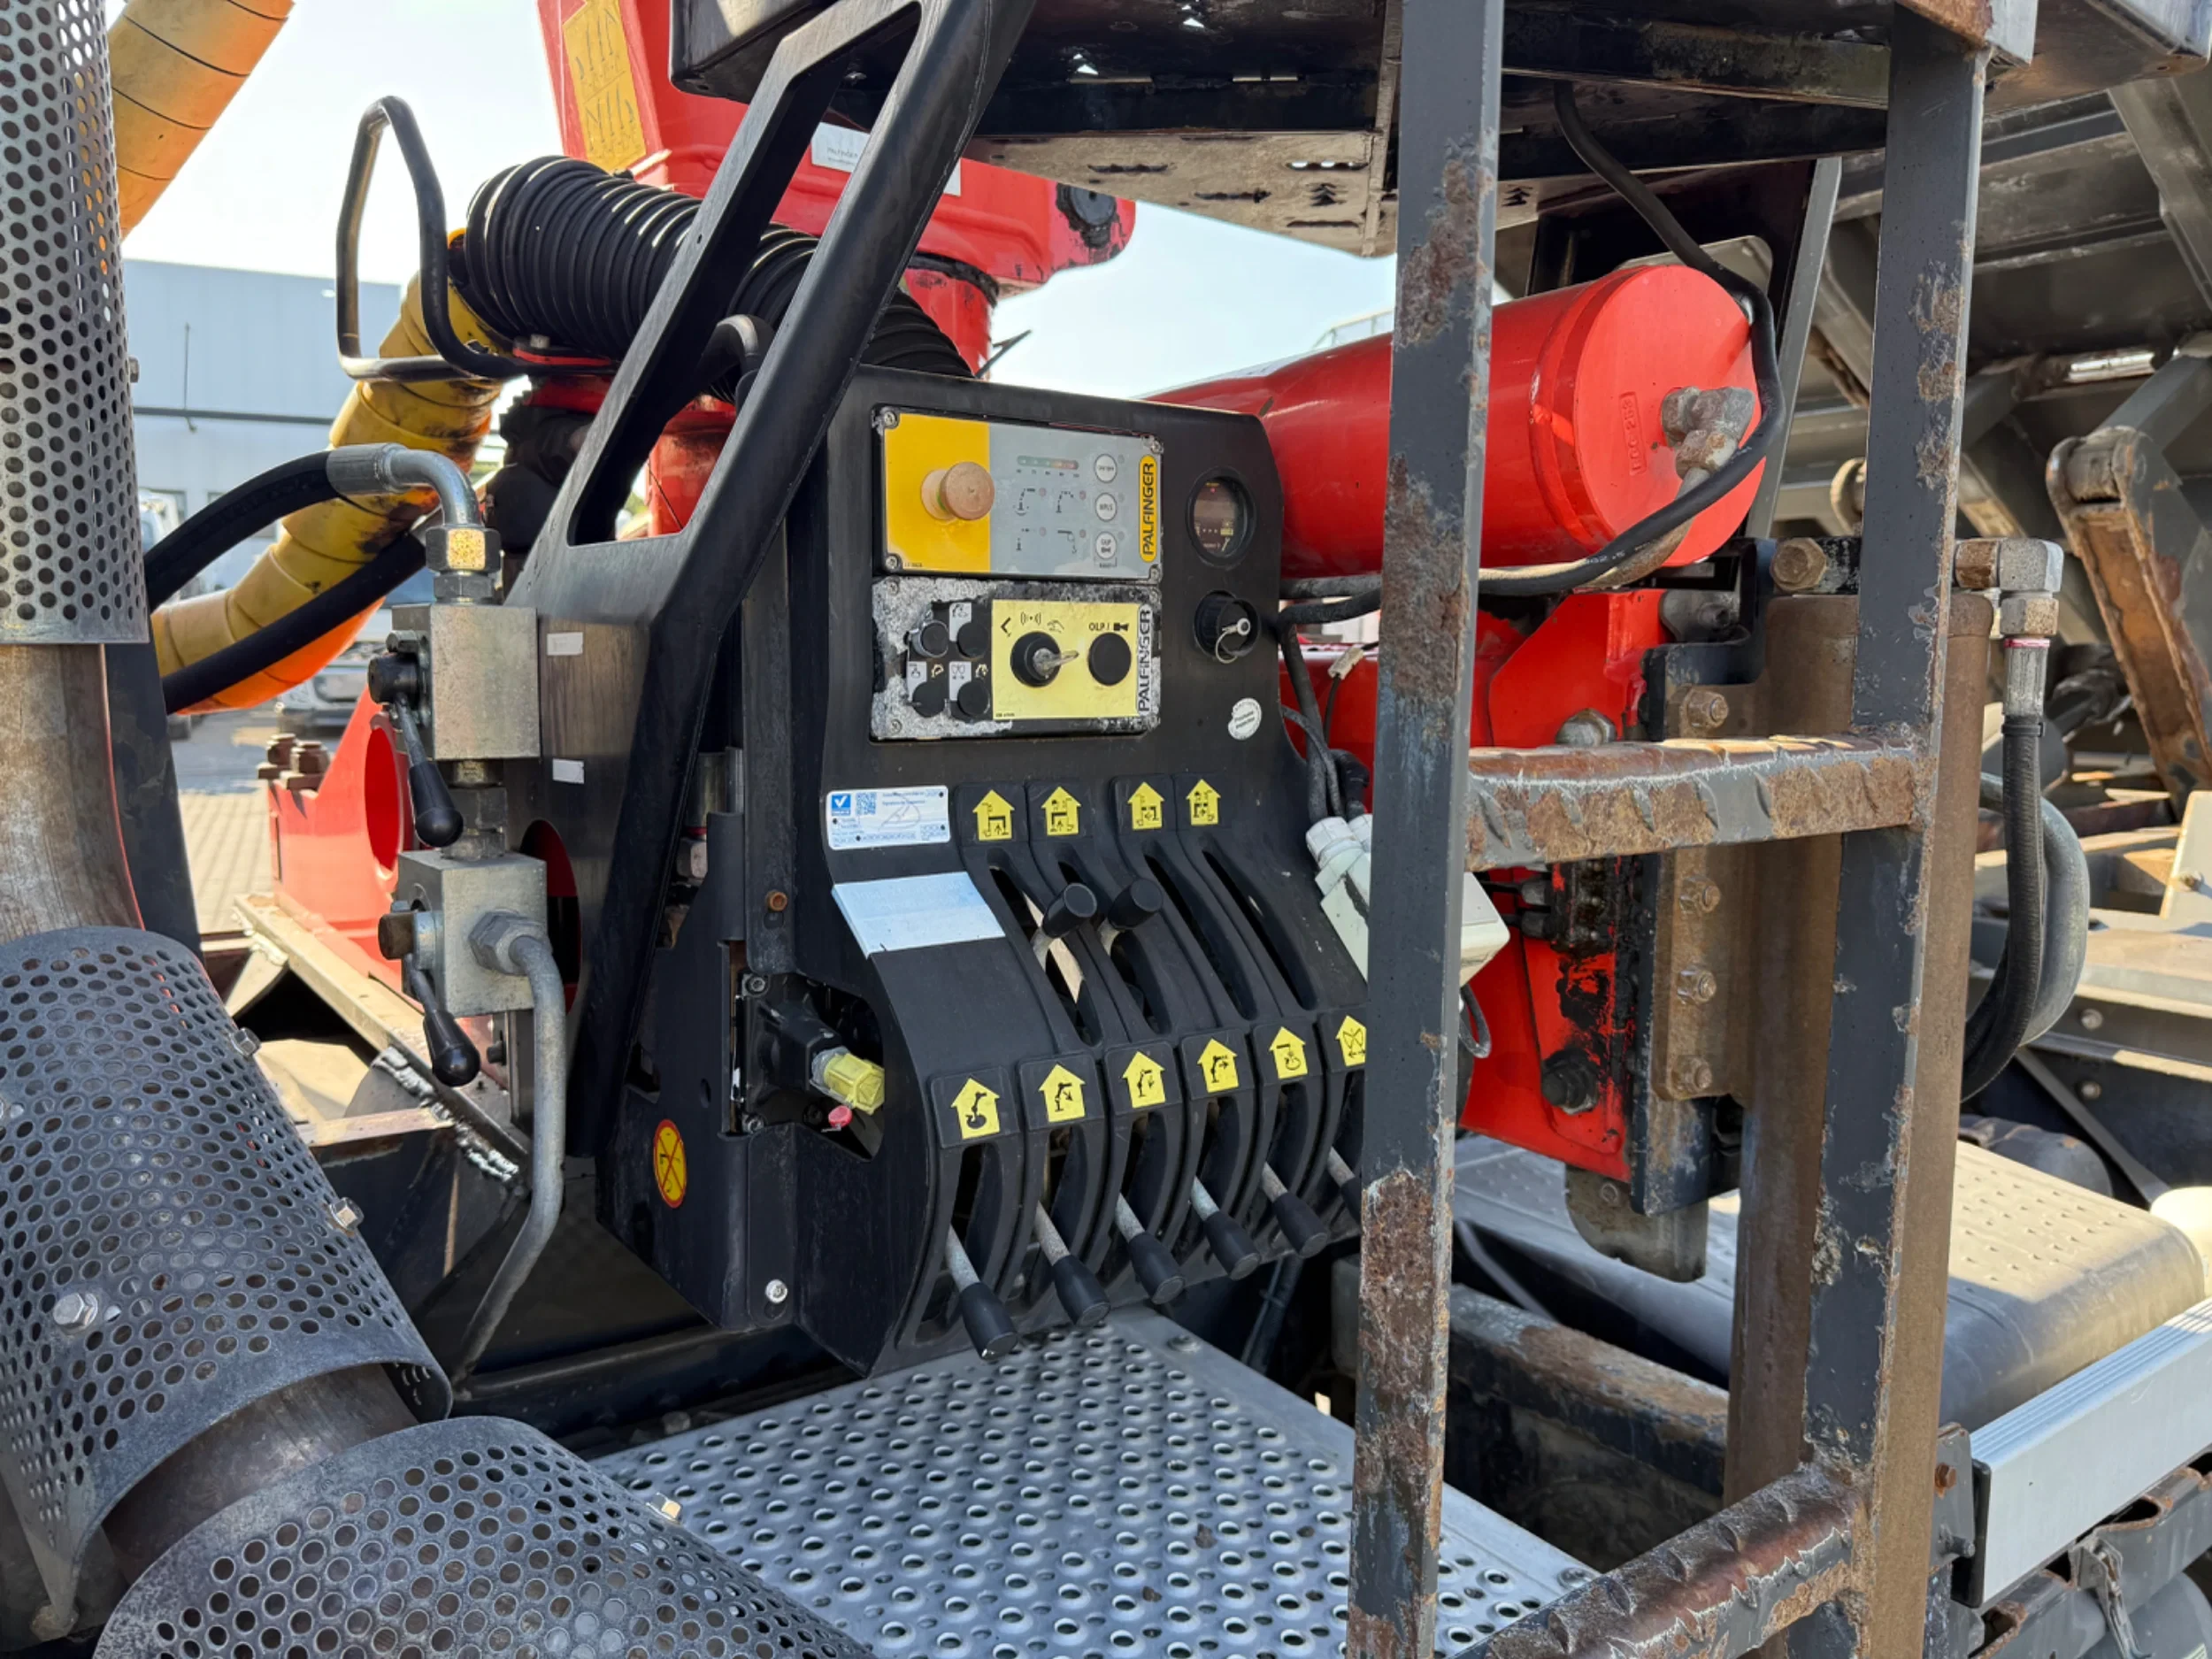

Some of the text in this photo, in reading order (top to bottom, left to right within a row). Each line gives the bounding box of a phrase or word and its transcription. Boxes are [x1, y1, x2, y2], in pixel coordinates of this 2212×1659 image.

[1142, 462, 1155, 556] PALFINGER
[1088, 622, 1105, 631] OLP
[1137, 609, 1151, 712] PALFINGER
